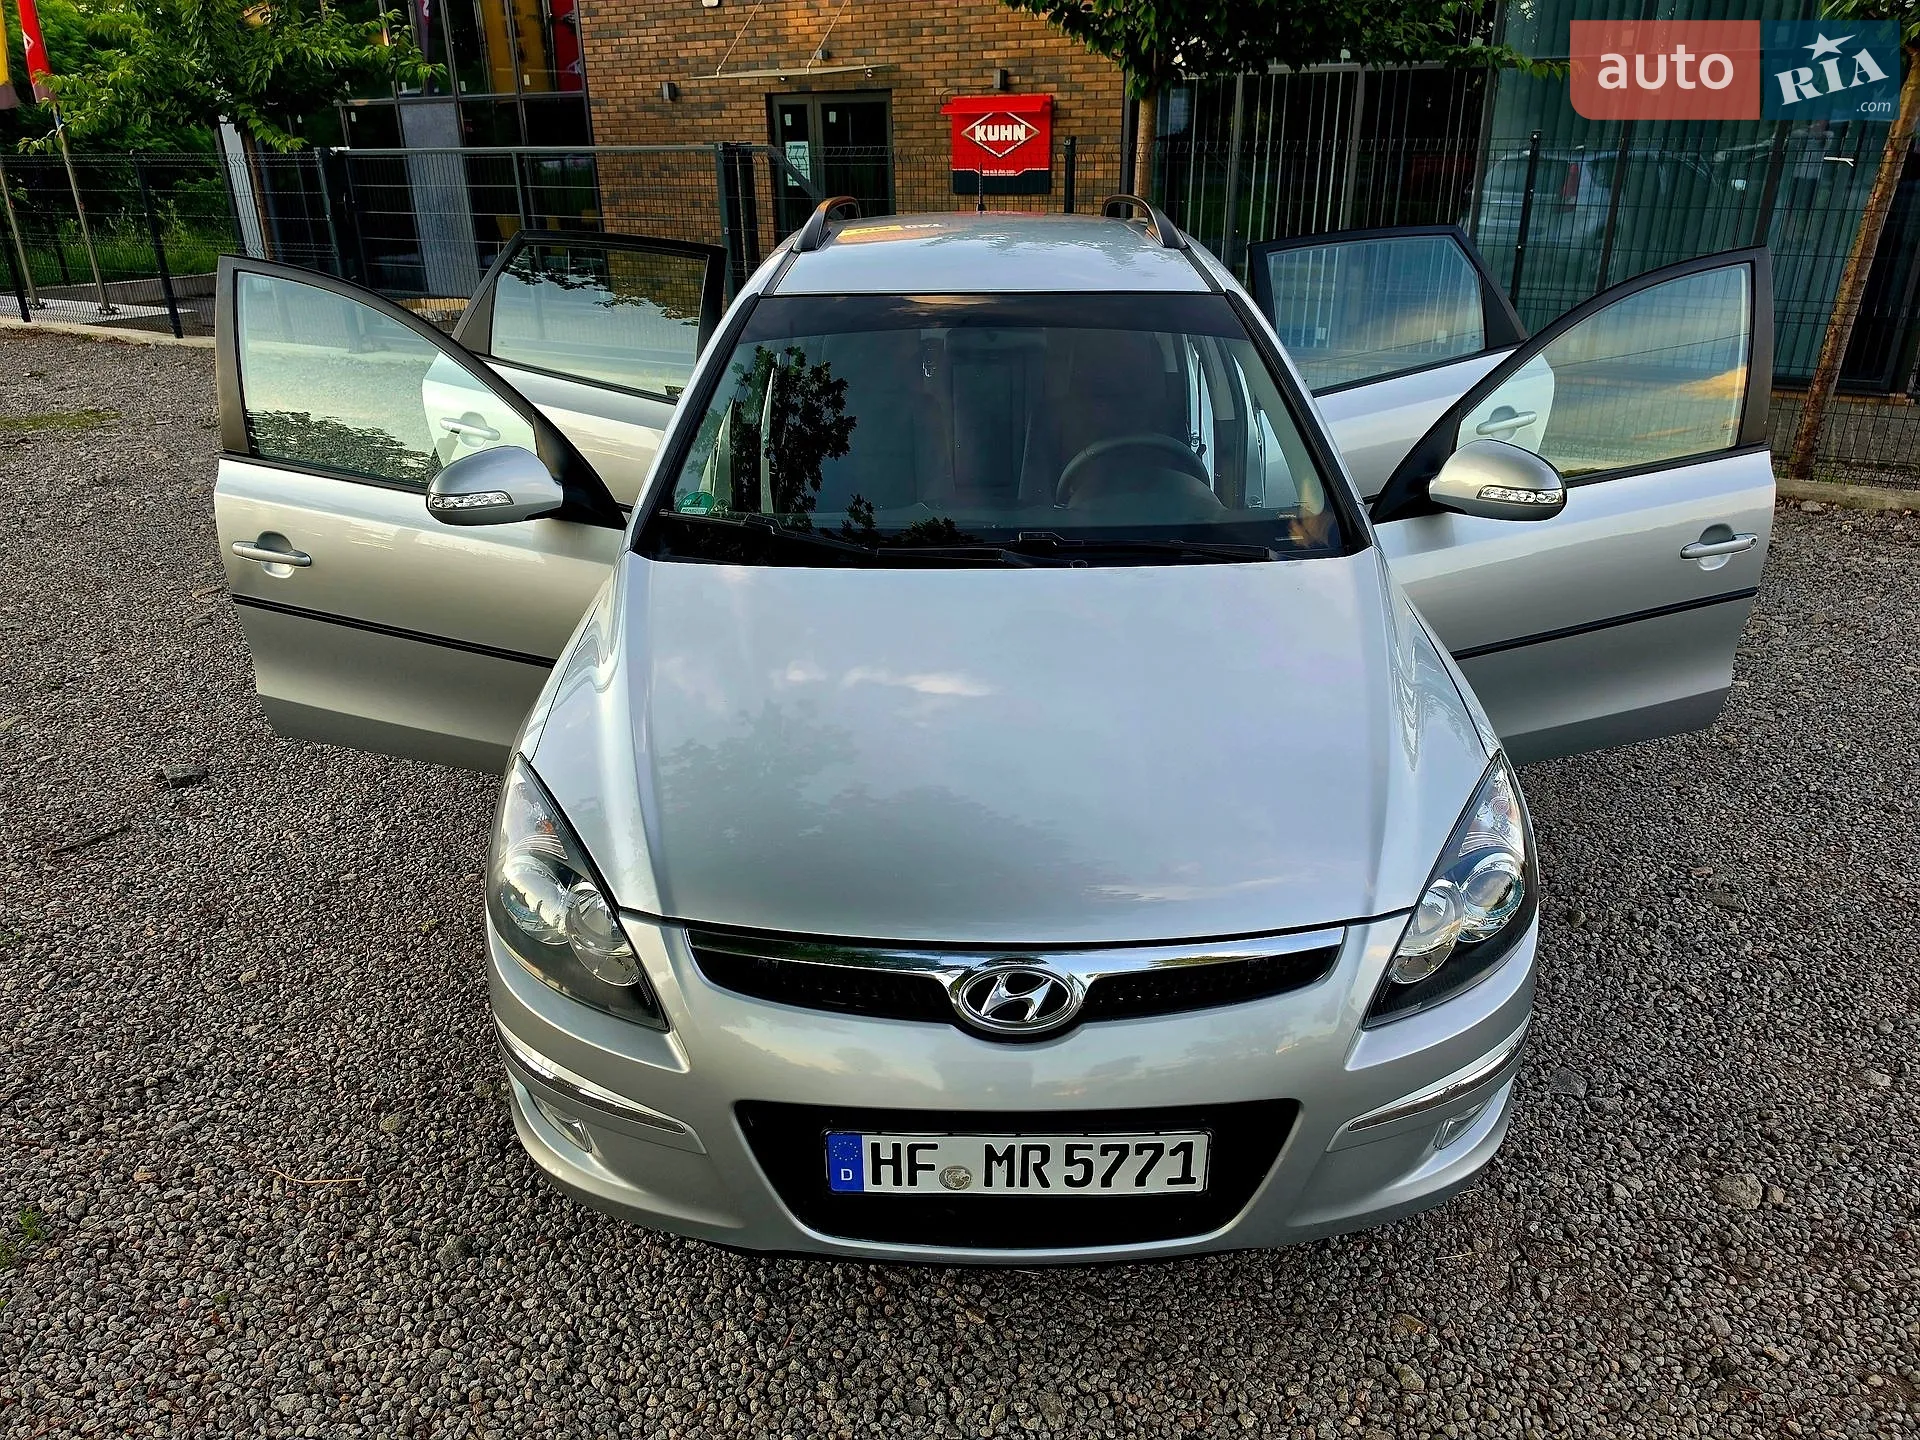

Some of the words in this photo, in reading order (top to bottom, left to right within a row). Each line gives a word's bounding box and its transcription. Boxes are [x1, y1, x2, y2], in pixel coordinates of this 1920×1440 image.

[974, 124, 1026, 142] KUHN
[870, 1141, 939, 1187] HF
[983, 1143, 1051, 1189] MR
[1063, 1140, 1197, 1188] 5771
[840, 1168, 853, 1181] D
